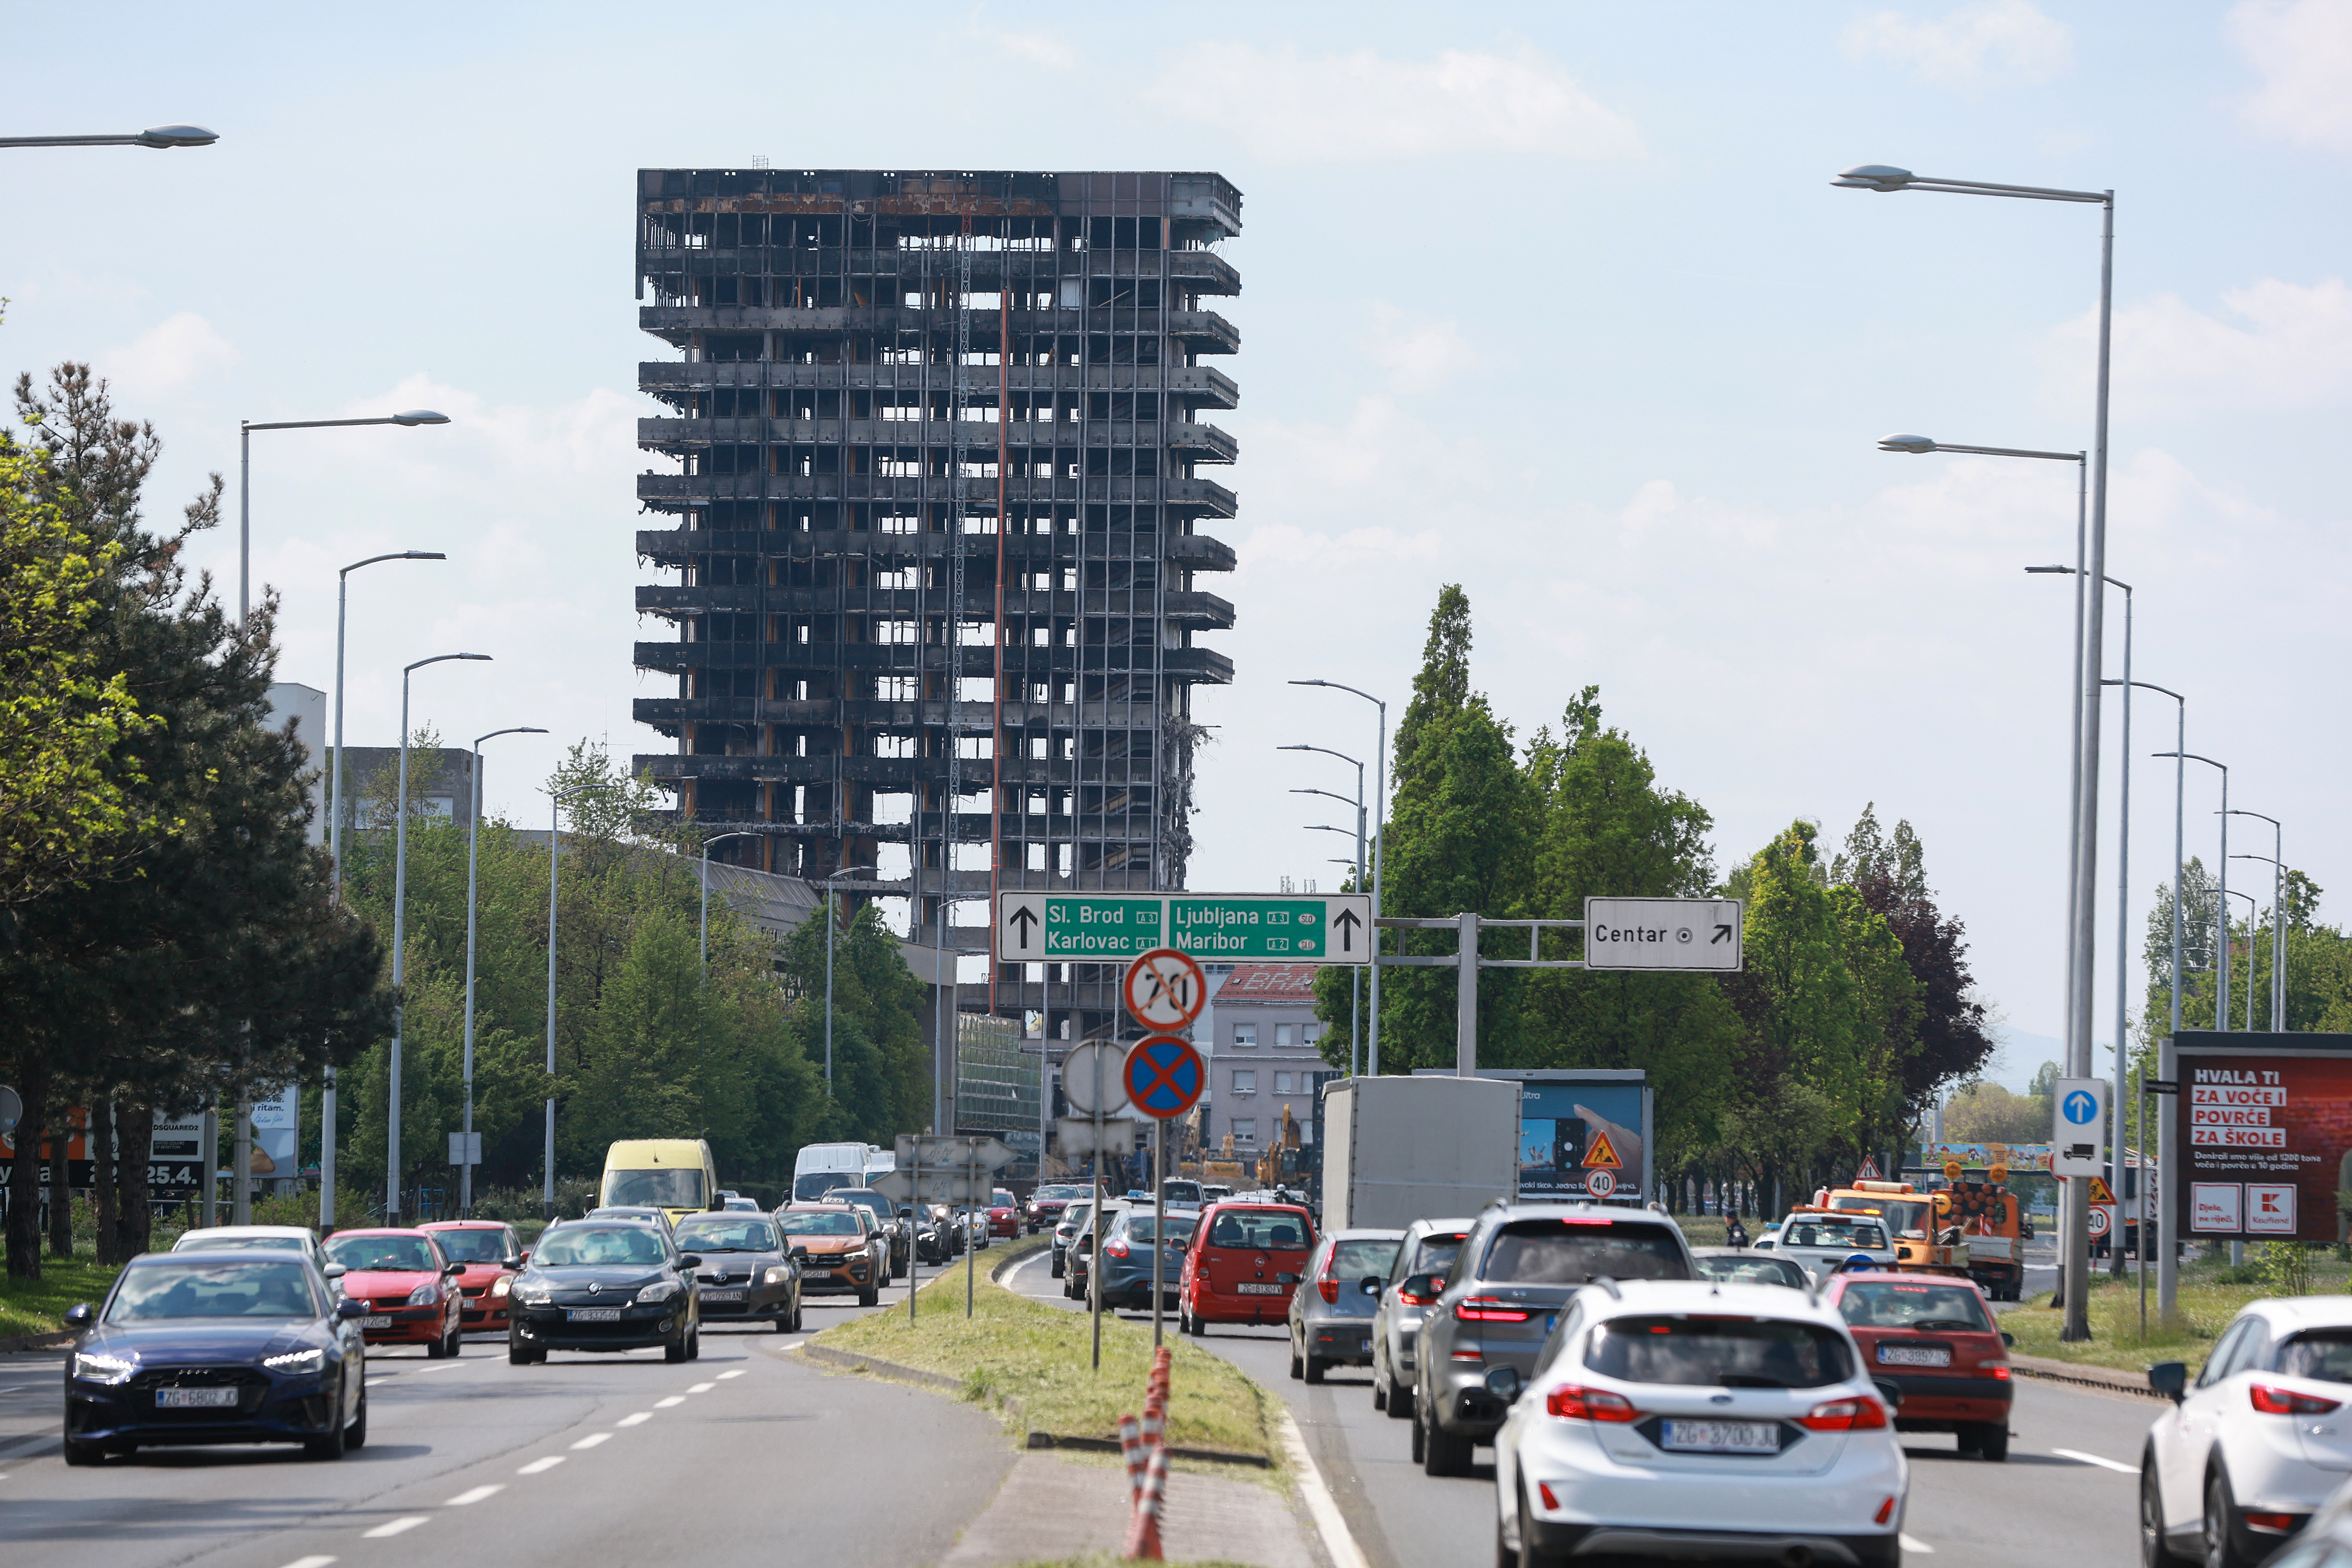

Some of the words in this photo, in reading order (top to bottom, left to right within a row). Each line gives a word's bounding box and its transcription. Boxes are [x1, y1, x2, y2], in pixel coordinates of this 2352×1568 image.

[1049, 905, 1071, 923] Sl.
[1080, 906, 1123, 923] Brod
[1177, 907, 1259, 928] Ljubljana
[1301, 915, 1313, 923] SLO
[1048, 931, 1130, 949] Karlovac
[1177, 931, 1248, 949] Maribor
[1596, 924, 1667, 942] Centar
[1301, 941, 1313, 950] SLO
[1242, 972, 1317, 990] BRA
[1145, 973, 1187, 1010] 70
[2194, 1068, 2257, 1084] HVALA
[2261, 1071, 2280, 1085] TI
[2196, 1090, 2219, 1103] ZA
[2279, 1093, 2283, 1104] I
[2195, 1131, 2219, 1144] ZA
[2225, 1128, 2282, 1145] ŠKOLE
[147, 1165, 197, 1184] 25.4.
[1593, 1177, 1609, 1191] 40
[2252, 1216, 2289, 1225] Kaufland
[1243, 1285, 1252, 1294] ZG
[572, 1311, 583, 1320] ZG
[1887, 1350, 1901, 1361] ZG
[165, 1391, 180, 1406] ZG
[1676, 1424, 1698, 1444] ZG
